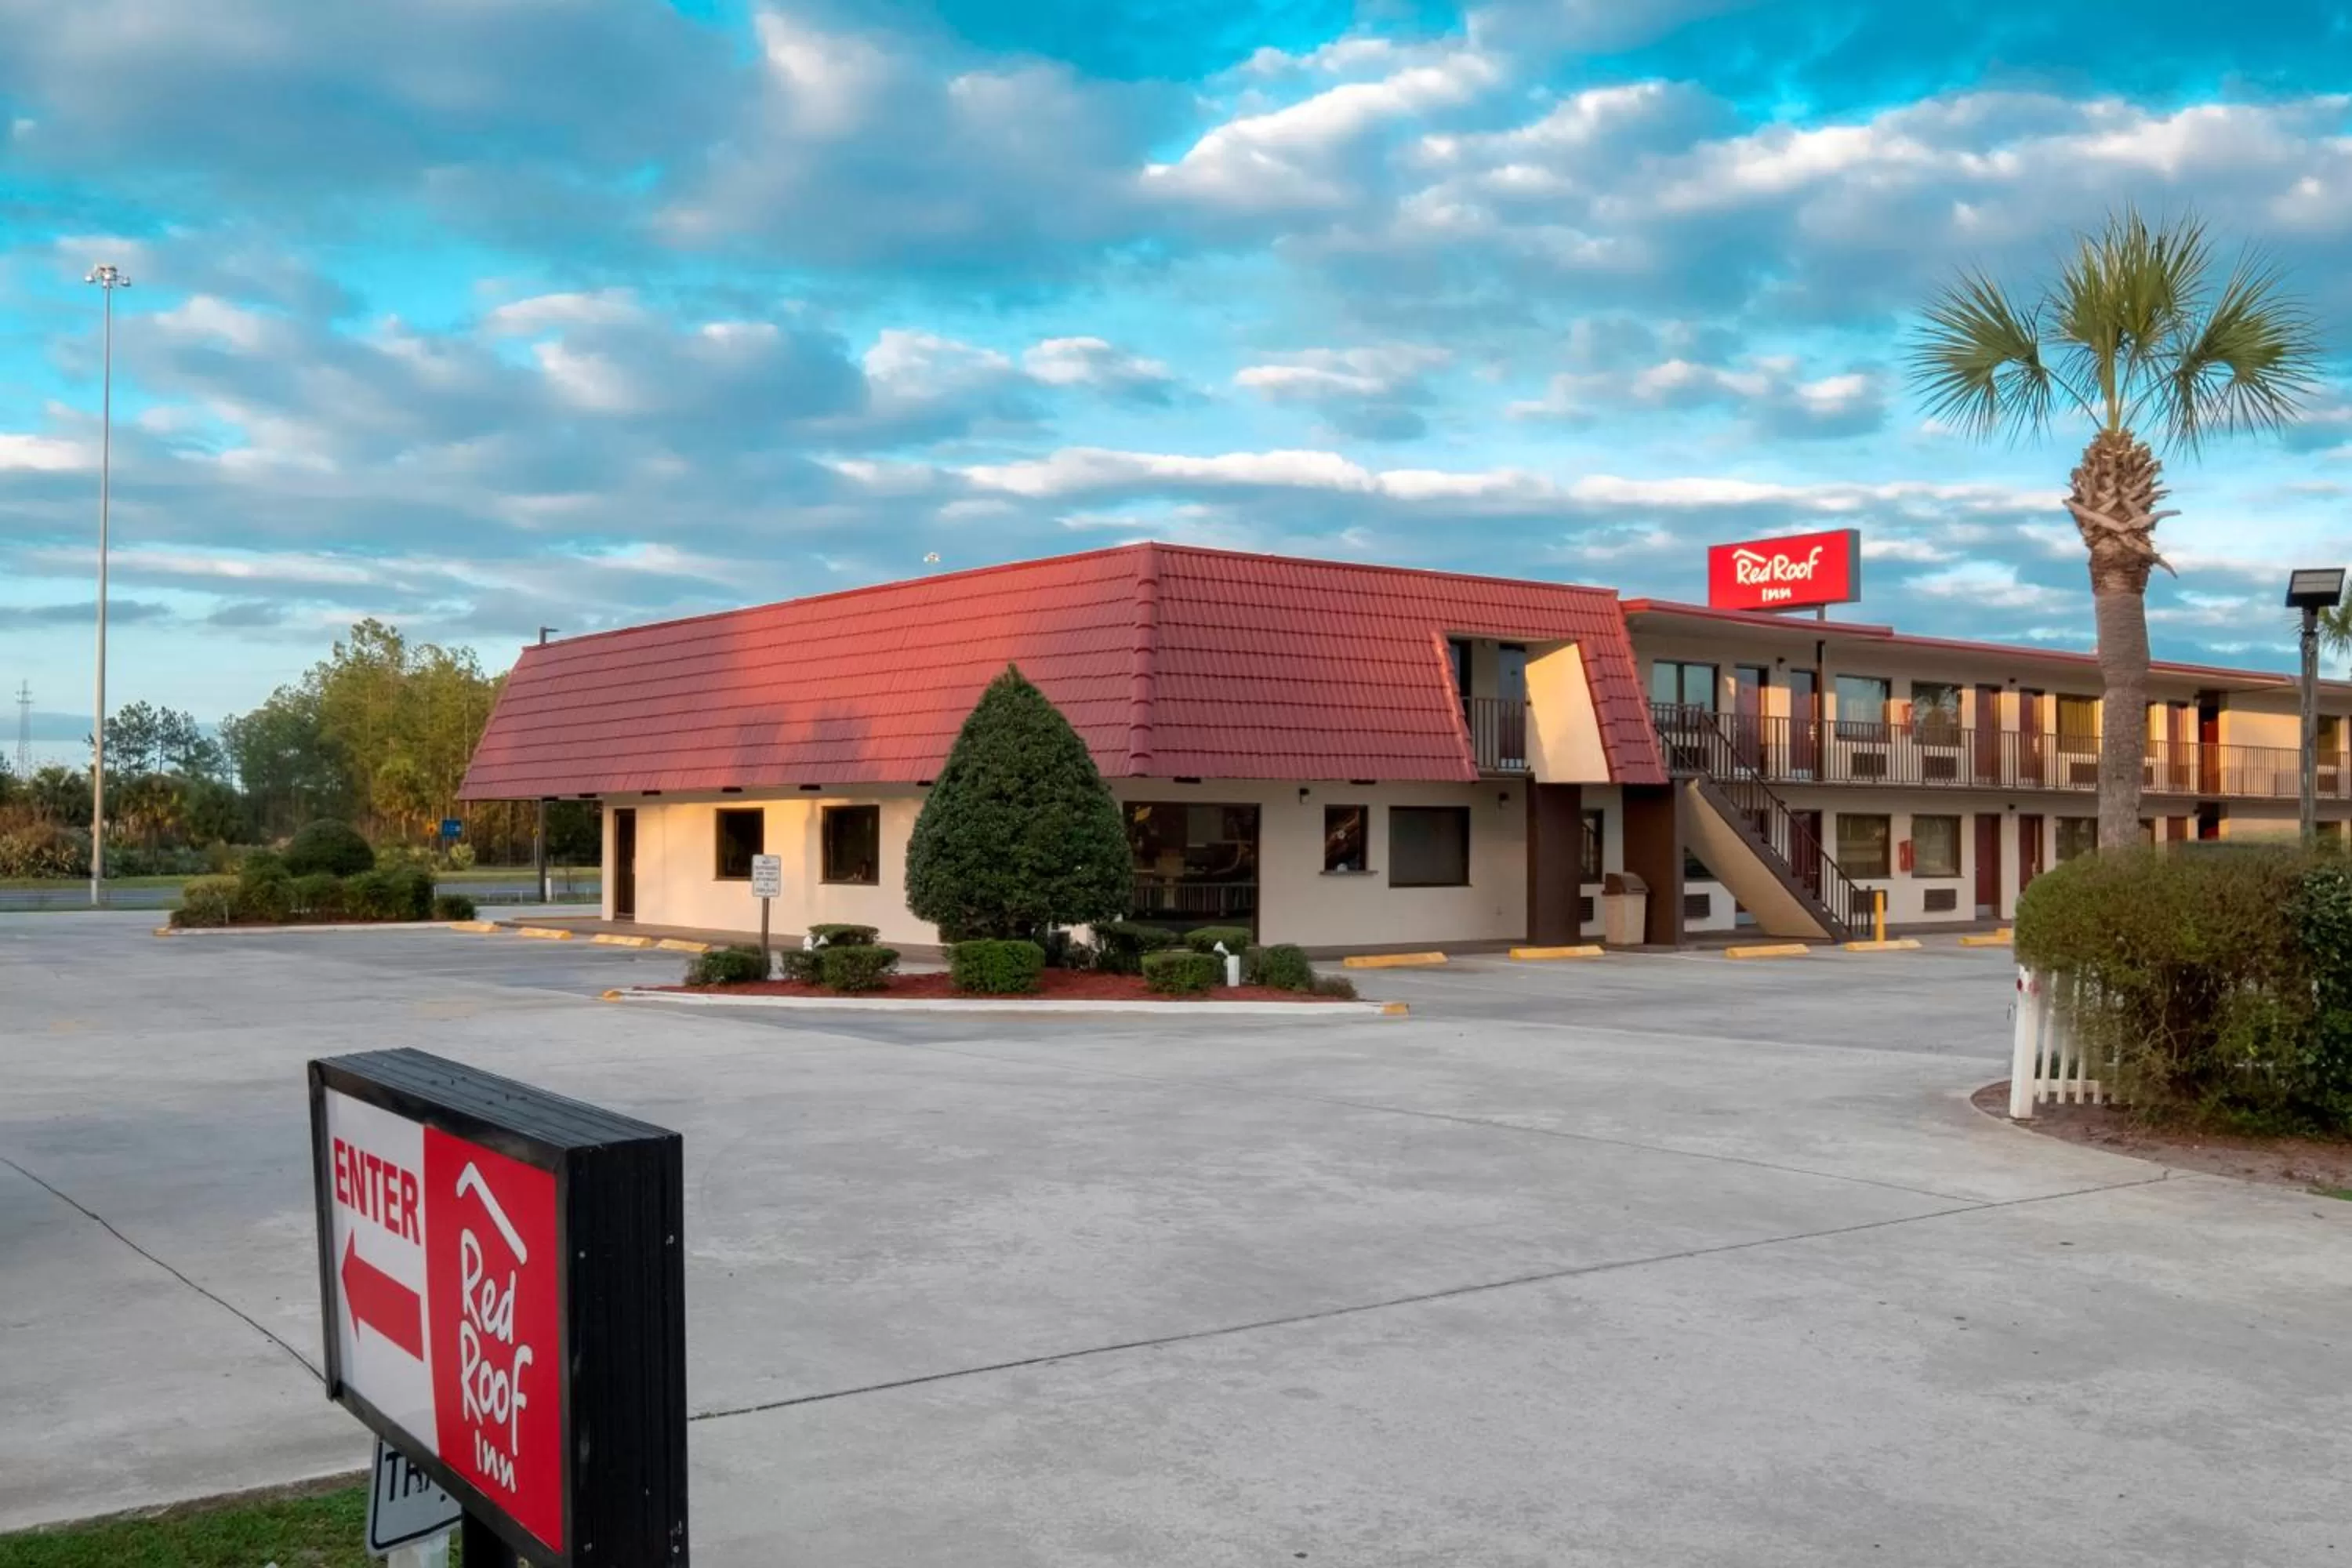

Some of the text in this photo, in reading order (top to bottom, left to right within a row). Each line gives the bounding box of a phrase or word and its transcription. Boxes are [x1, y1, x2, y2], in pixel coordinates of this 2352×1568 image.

[1736, 546, 1823, 586] Red Roof
[334, 1137, 420, 1246] ENTER
[461, 1229, 517, 1345] Red
[461, 1321, 533, 1456] Roof
